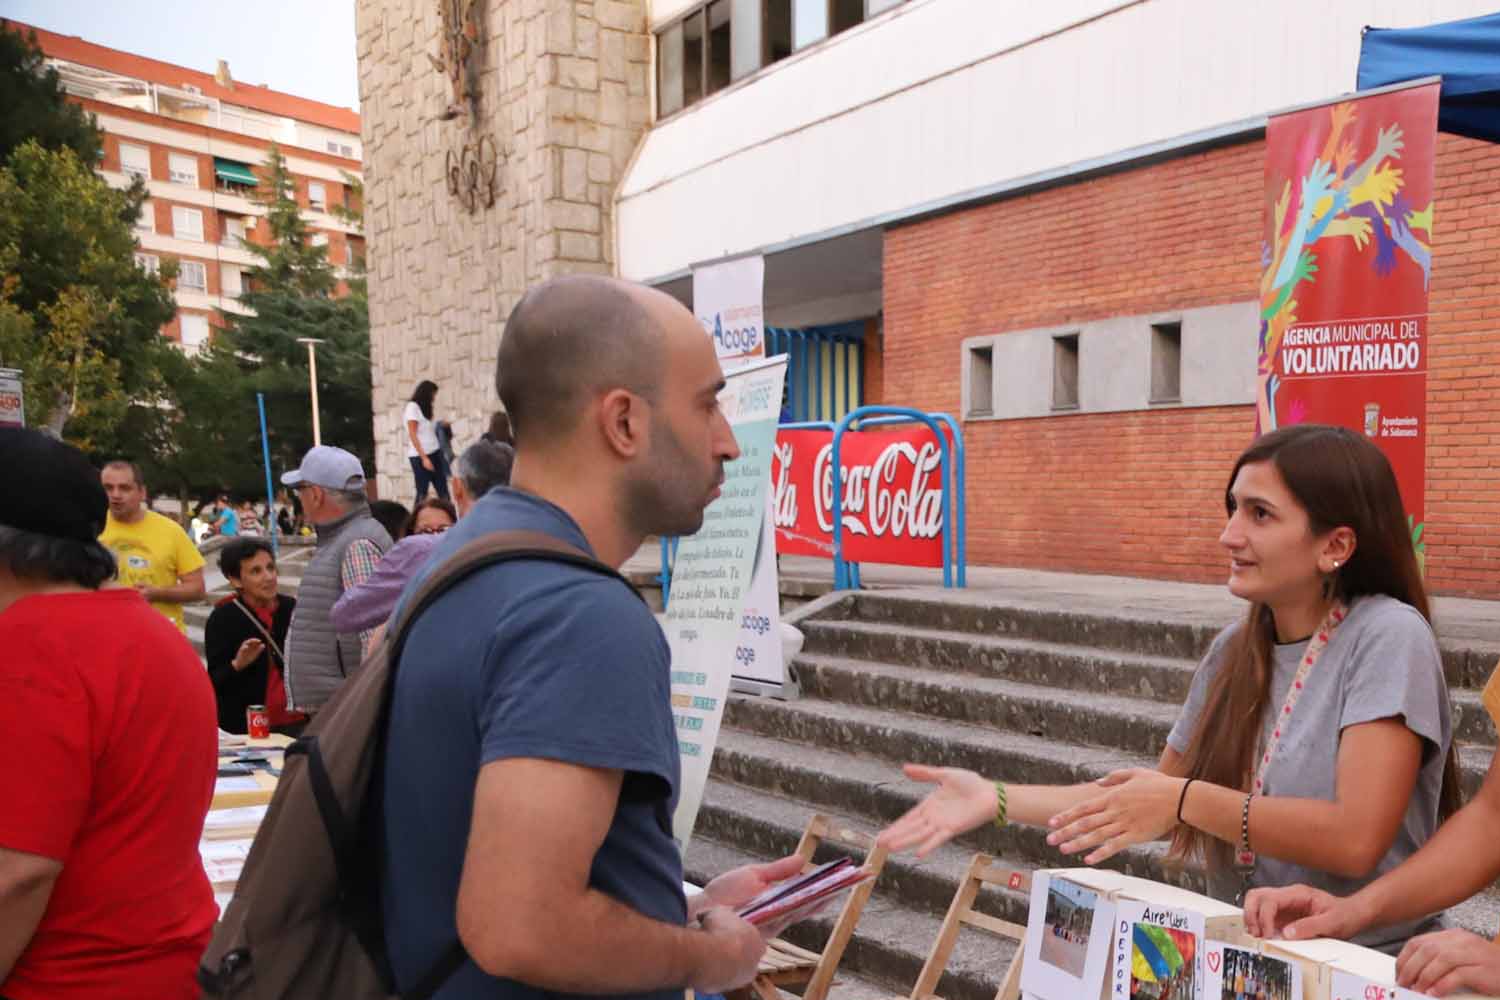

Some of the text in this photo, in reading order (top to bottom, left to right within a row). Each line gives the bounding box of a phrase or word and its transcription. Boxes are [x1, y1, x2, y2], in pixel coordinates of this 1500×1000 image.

[1282, 319, 1421, 347] AGENCIA MUNICIPAL DEL
[1282, 341, 1420, 375] VOLUNTARIADO
[812, 441, 944, 541] Coca-Cola
